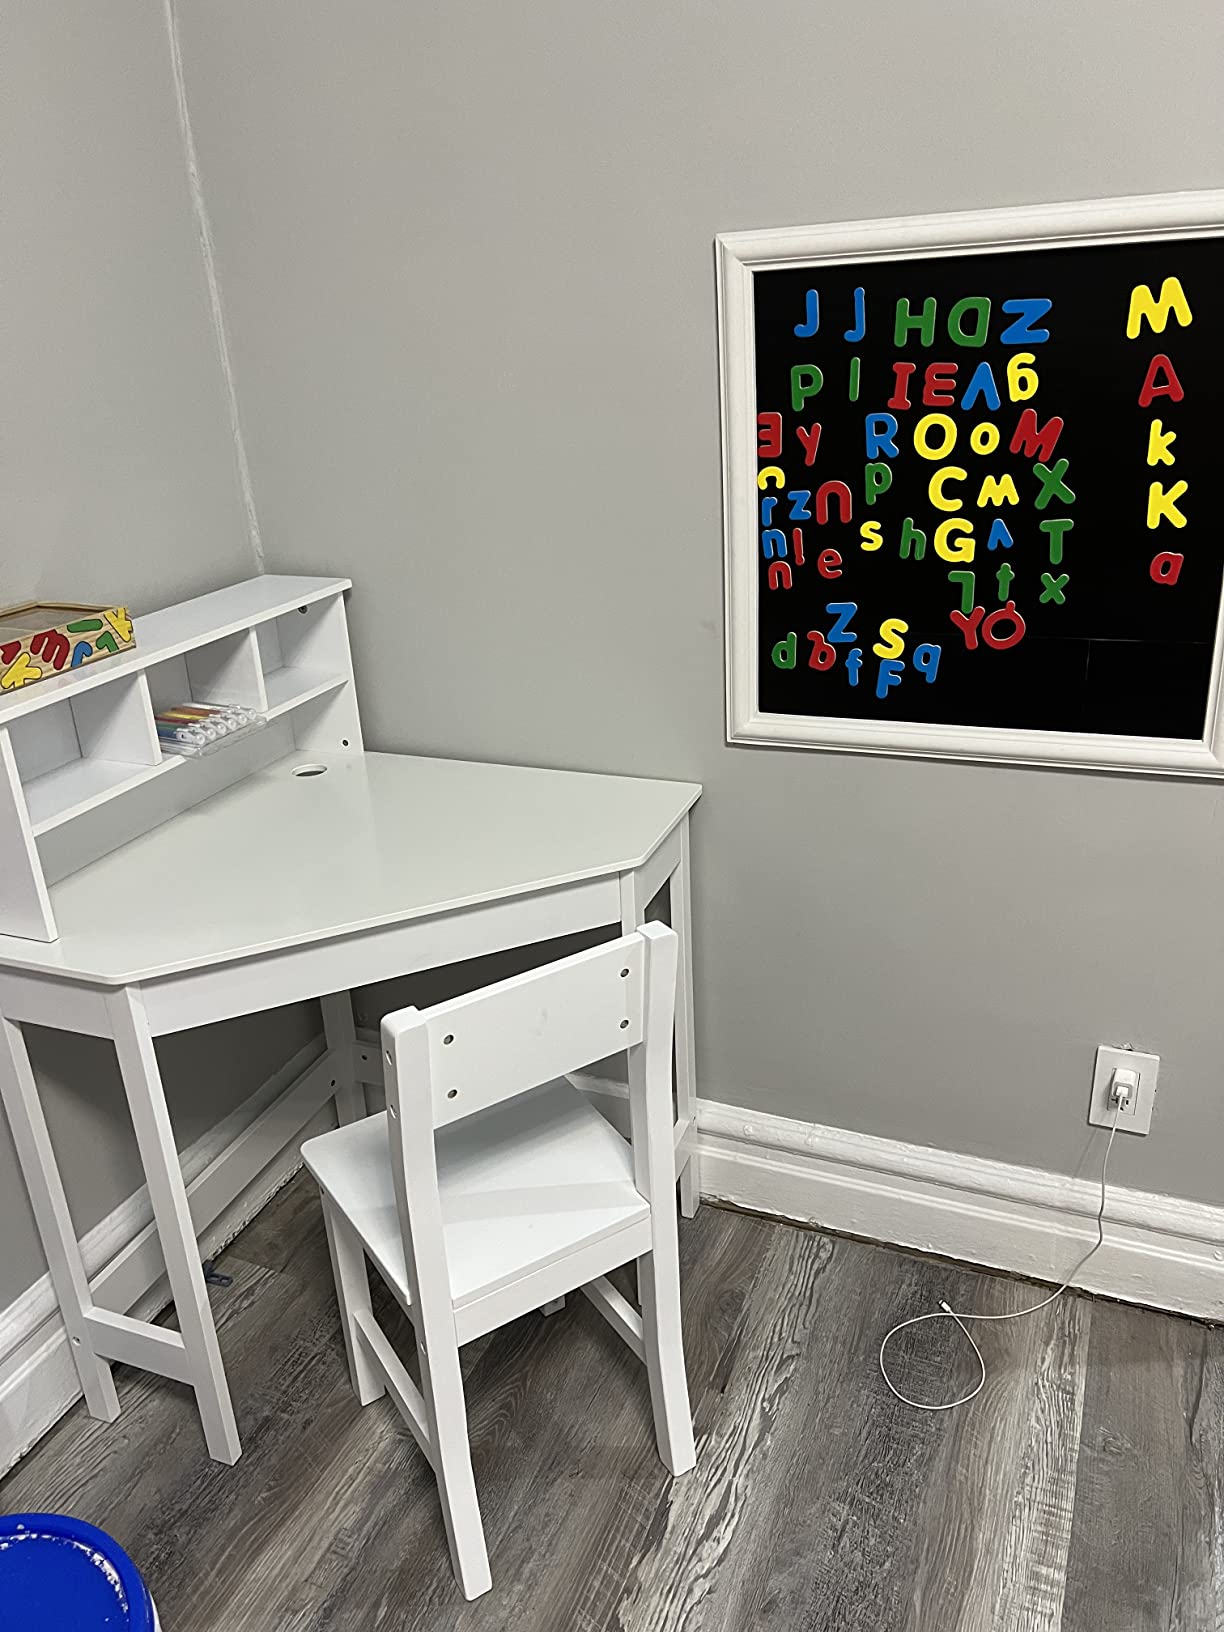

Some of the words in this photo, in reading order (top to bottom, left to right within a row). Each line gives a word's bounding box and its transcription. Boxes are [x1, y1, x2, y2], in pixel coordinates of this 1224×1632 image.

[893, 298, 936, 348] H
[921, 363, 959, 407] E
[1137, 353, 1185, 408] A
[864, 412, 899, 460] R
[1008, 408, 1064, 463] M
[899, 518, 925, 561] h
[933, 518, 977, 564] G
[1039, 520, 1073, 565] T
[816, 549, 843, 580] e
[844, 649, 863, 687] f
[875, 659, 906, 699] F
